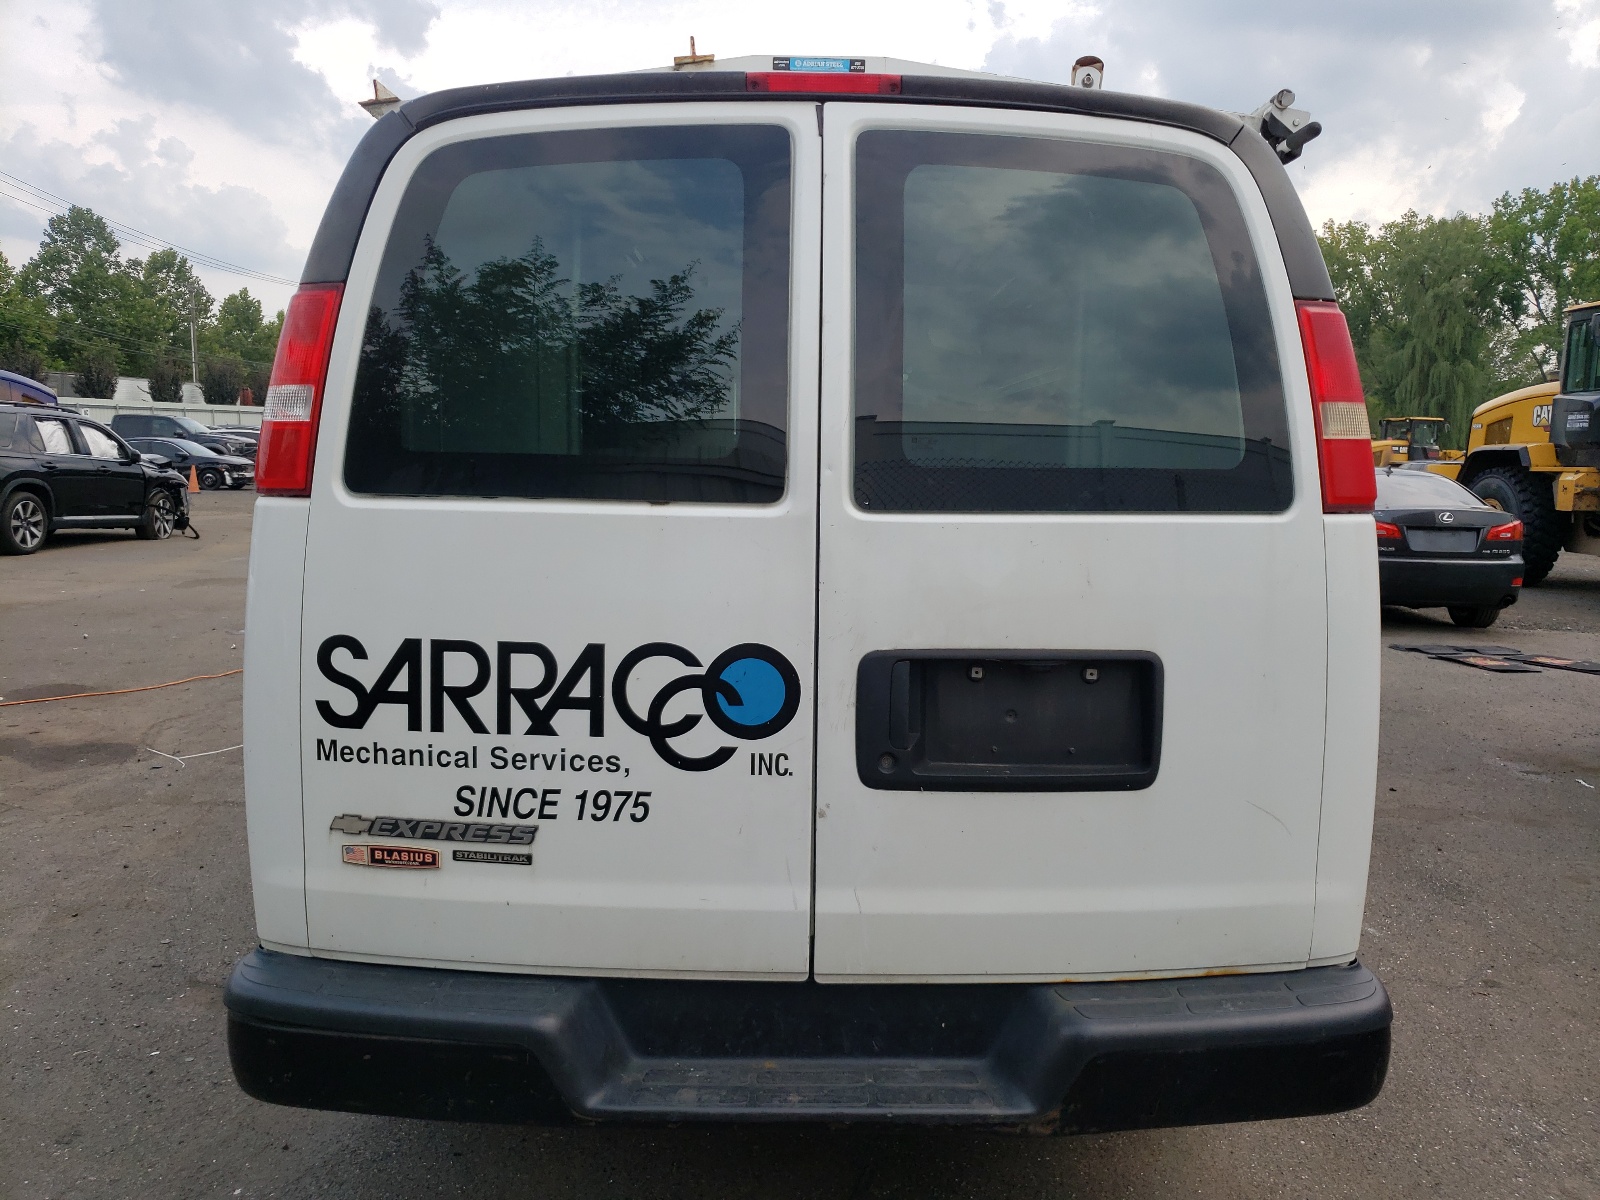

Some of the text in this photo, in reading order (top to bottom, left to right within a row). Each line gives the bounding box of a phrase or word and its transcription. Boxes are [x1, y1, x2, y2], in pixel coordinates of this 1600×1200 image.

[316, 739, 631, 777] Mechanical Services,
[750, 753, 794, 777] INC.
[453, 785, 651, 822] SINCE 1975
[369, 817, 537, 844] EXPRESS
[374, 850, 433, 863] BLASIUS
[456, 852, 528, 862] STABILITRAK
